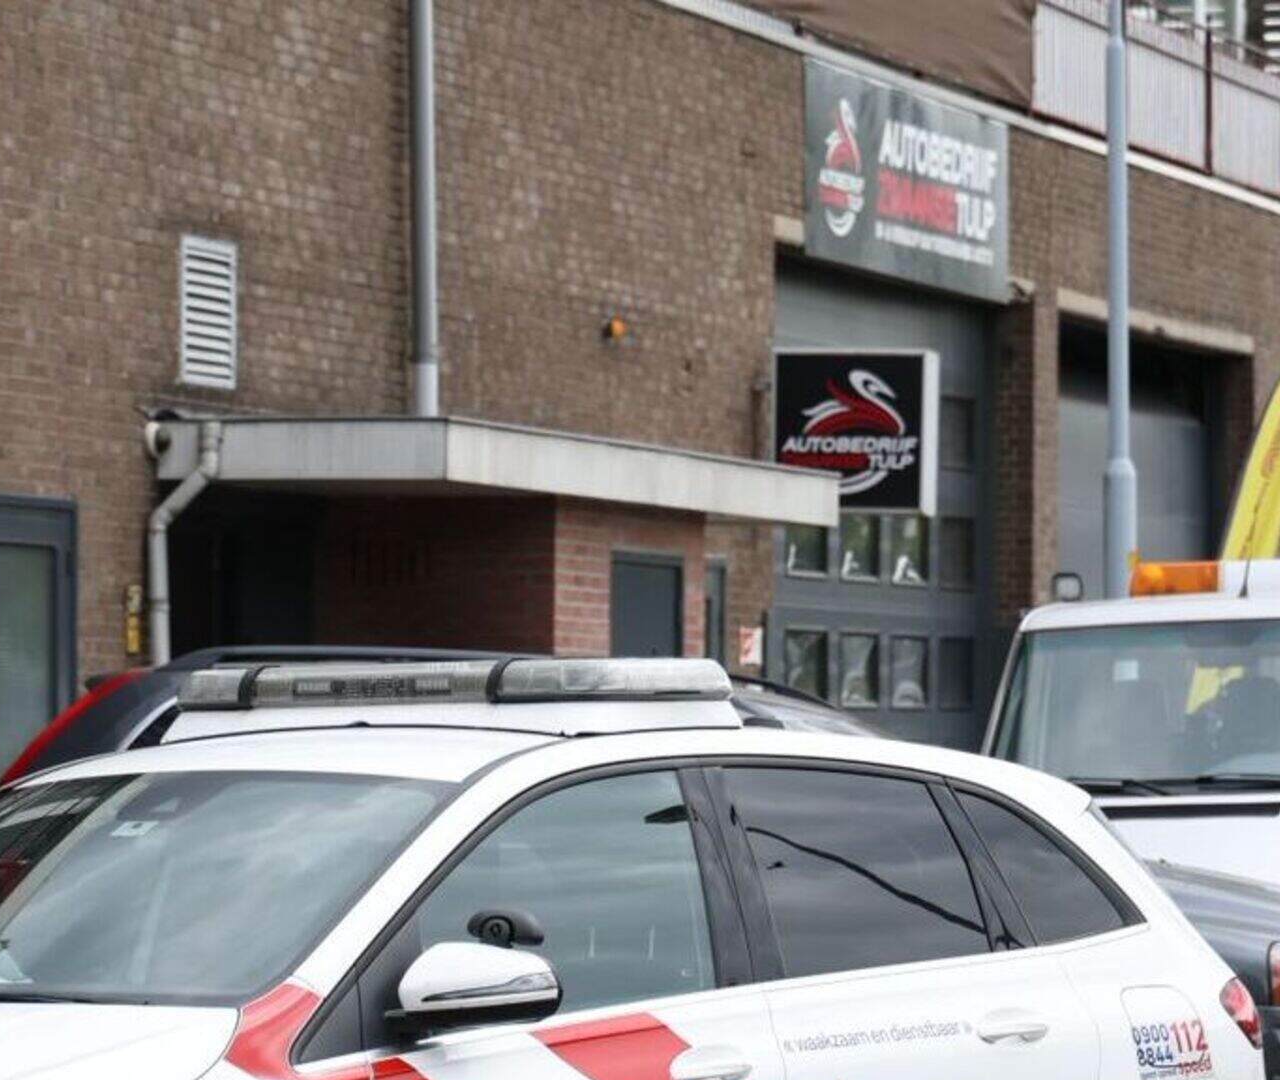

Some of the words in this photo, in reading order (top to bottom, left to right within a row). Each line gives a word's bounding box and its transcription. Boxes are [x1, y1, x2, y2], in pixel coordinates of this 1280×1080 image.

[955, 191, 997, 241] TULP
[781, 435, 918, 454] AUTOBEDRIJF
[868, 453, 915, 470] TULP
[1131, 1023, 1170, 1046] 0900
[1170, 1019, 1209, 1054] 112
[1136, 1045, 1174, 1067] 8844
